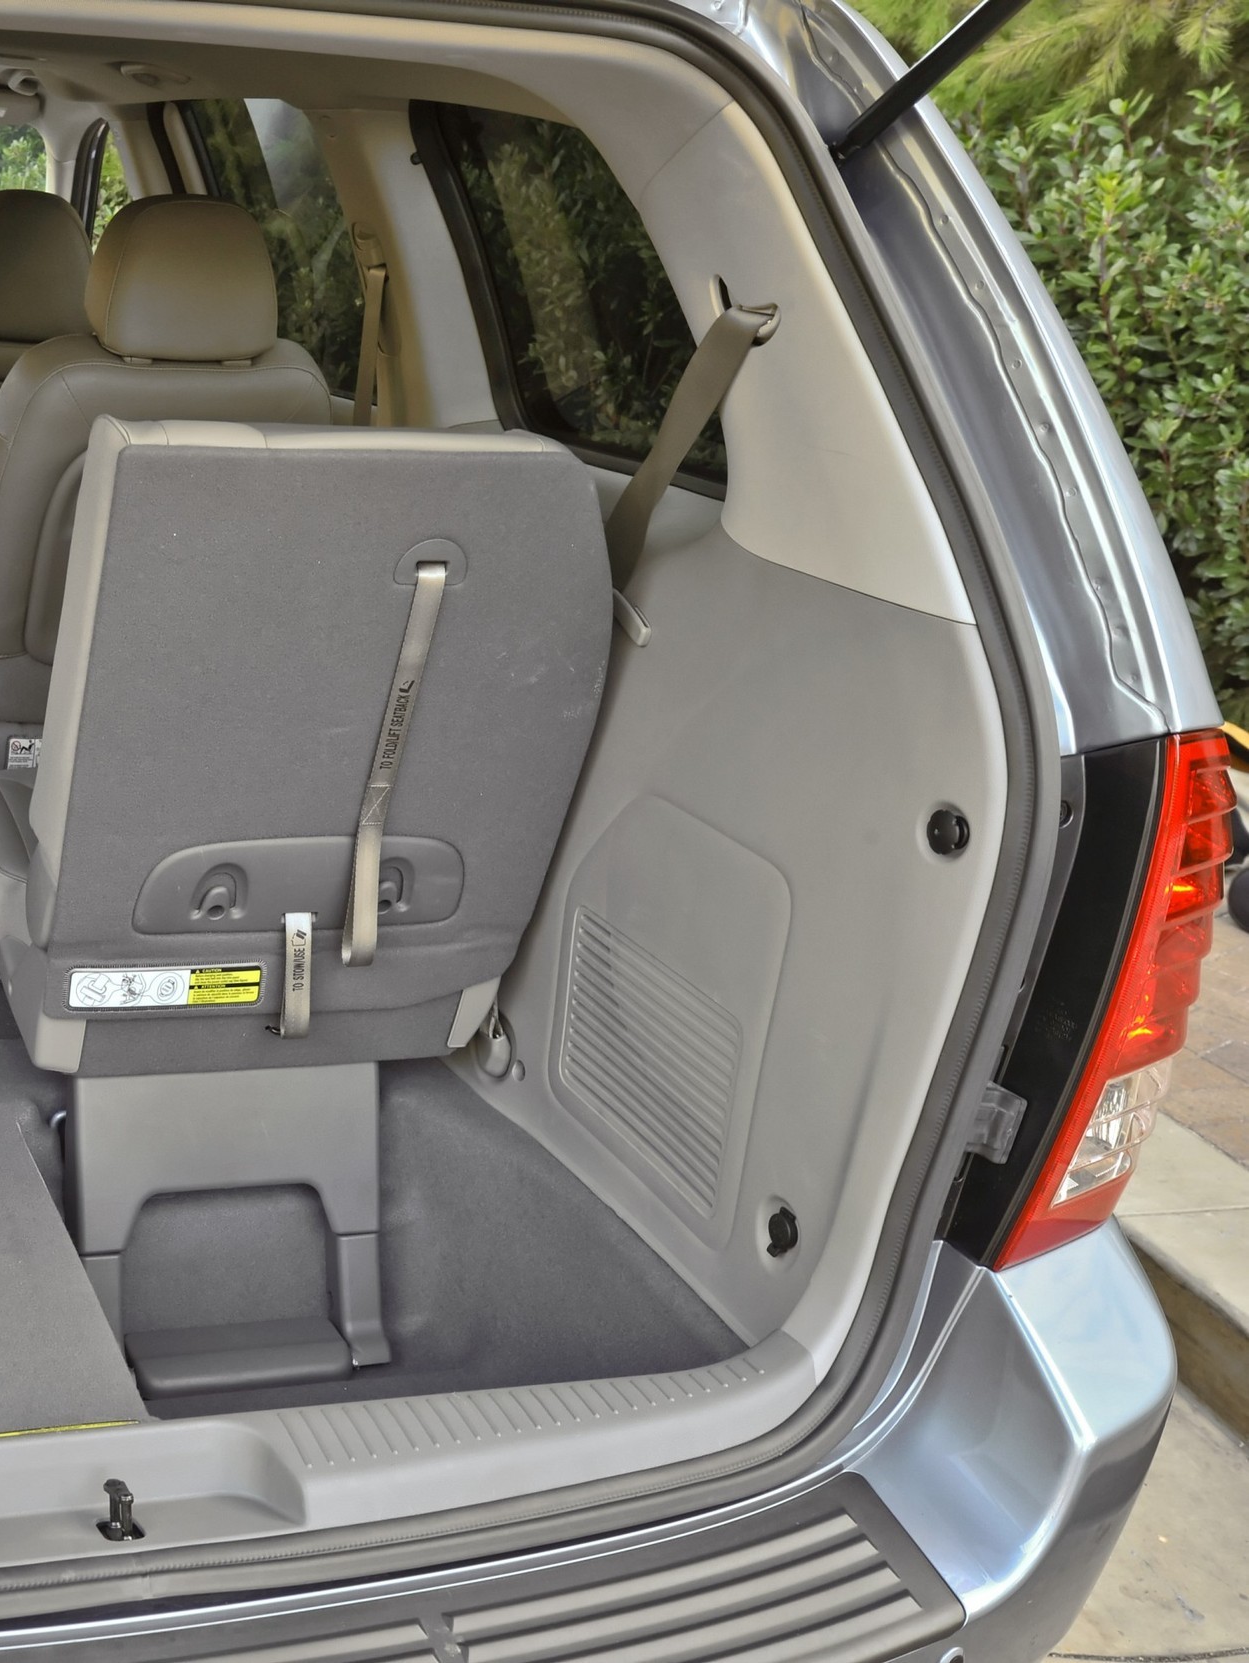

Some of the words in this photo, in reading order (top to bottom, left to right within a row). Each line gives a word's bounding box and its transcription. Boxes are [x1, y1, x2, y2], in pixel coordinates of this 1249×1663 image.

[391, 694, 411, 727] SEATBACK
[382, 727, 402, 759] FOLD/LIFT
[379, 760, 393, 770] TO
[292, 947, 306, 980] STOW/USE
[292, 982, 304, 992] TO
